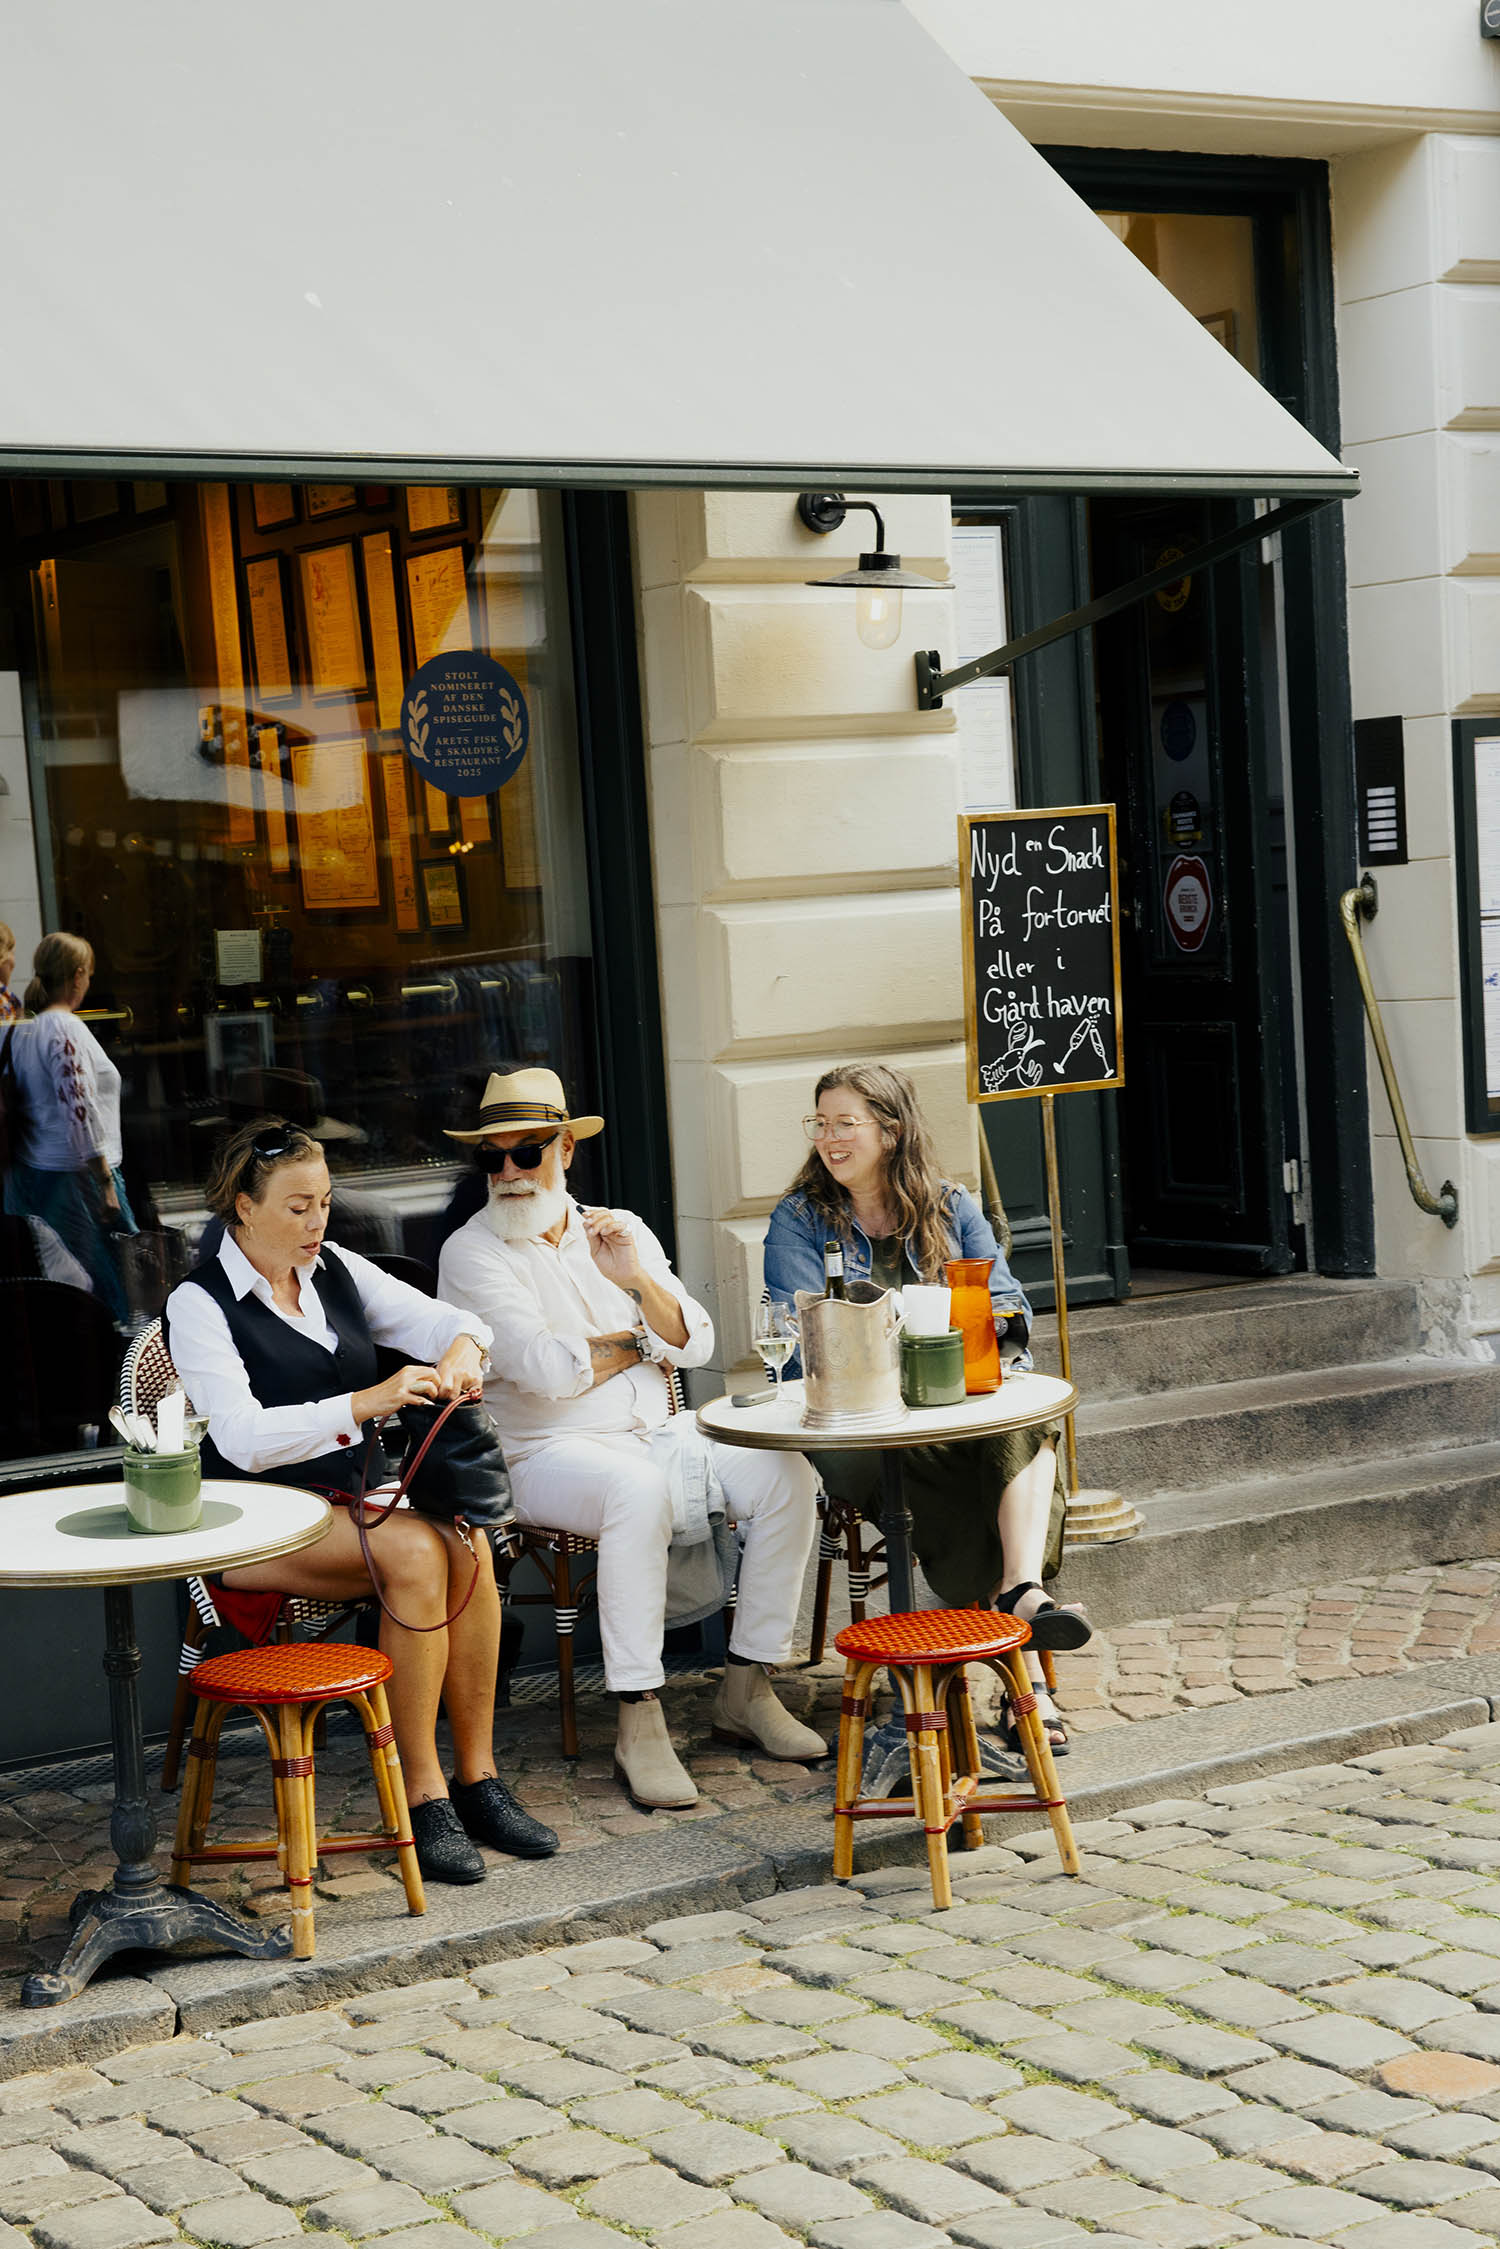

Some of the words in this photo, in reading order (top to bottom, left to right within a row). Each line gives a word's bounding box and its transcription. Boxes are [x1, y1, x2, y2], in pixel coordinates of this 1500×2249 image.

[445, 671, 479, 680] STOLT
[431, 681, 494, 692] NOMINERET
[443, 694, 457, 702] AF
[462, 692, 484, 701] DEN
[443, 703, 486, 713] DANSKE
[433, 713, 497, 724] SPISEGUIDE
[474, 735, 497, 744] FISK
[434, 748, 442, 756] &
[434, 757, 501, 767] RESTAURANT
[457, 768, 481, 777] 2025
[970, 828, 1023, 892] Nyd
[1025, 839, 1043, 852] en
[1046, 825, 1105, 875] Snack
[979, 899, 1005, 938] På
[1021, 885, 1112, 942] fortorvet
[986, 949, 1036, 980] eller
[1056, 947, 1066, 970] i
